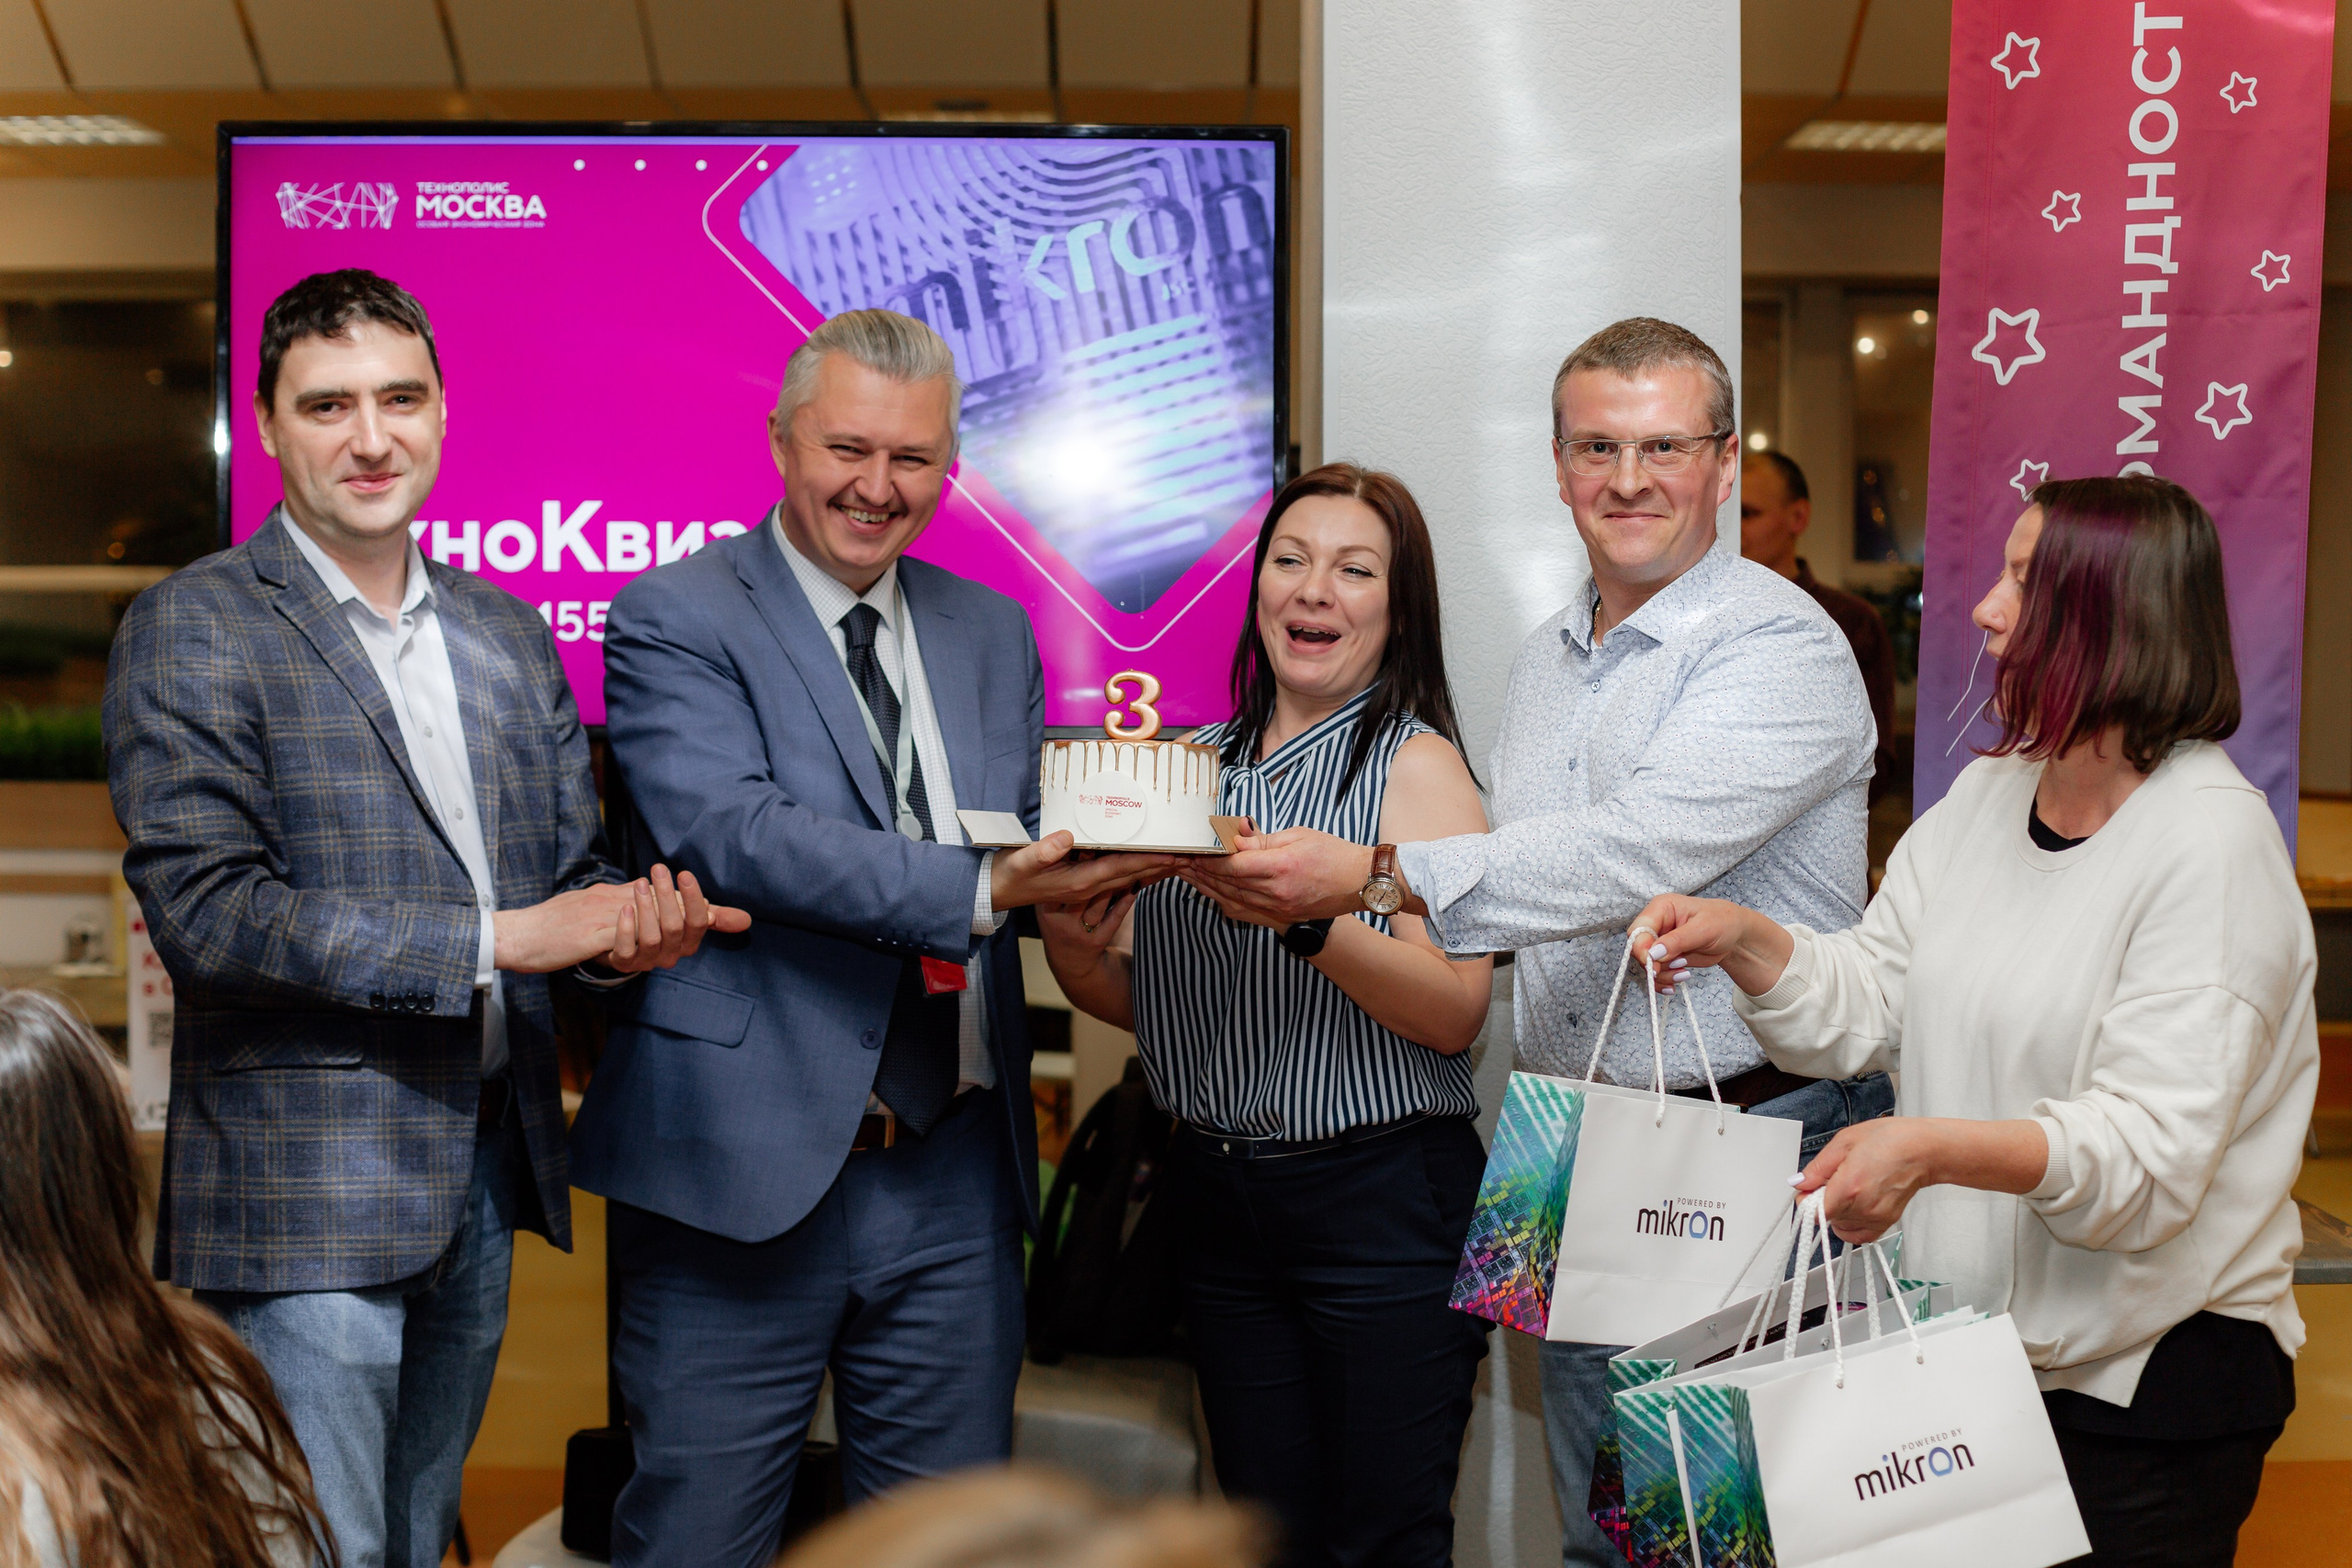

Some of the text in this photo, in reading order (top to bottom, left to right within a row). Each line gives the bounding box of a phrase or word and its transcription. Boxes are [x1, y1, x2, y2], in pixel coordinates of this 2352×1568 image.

[416, 182, 510, 194] ТЕХНОПОЛИС
[416, 195, 548, 220] МОСКВА
[1104, 669, 1162, 740] 3
[1105, 799, 1142, 808] MOSCOW
[1678, 1197, 1713, 1208] POWERED
[1901, 1427, 1962, 1452] POWERED BY
